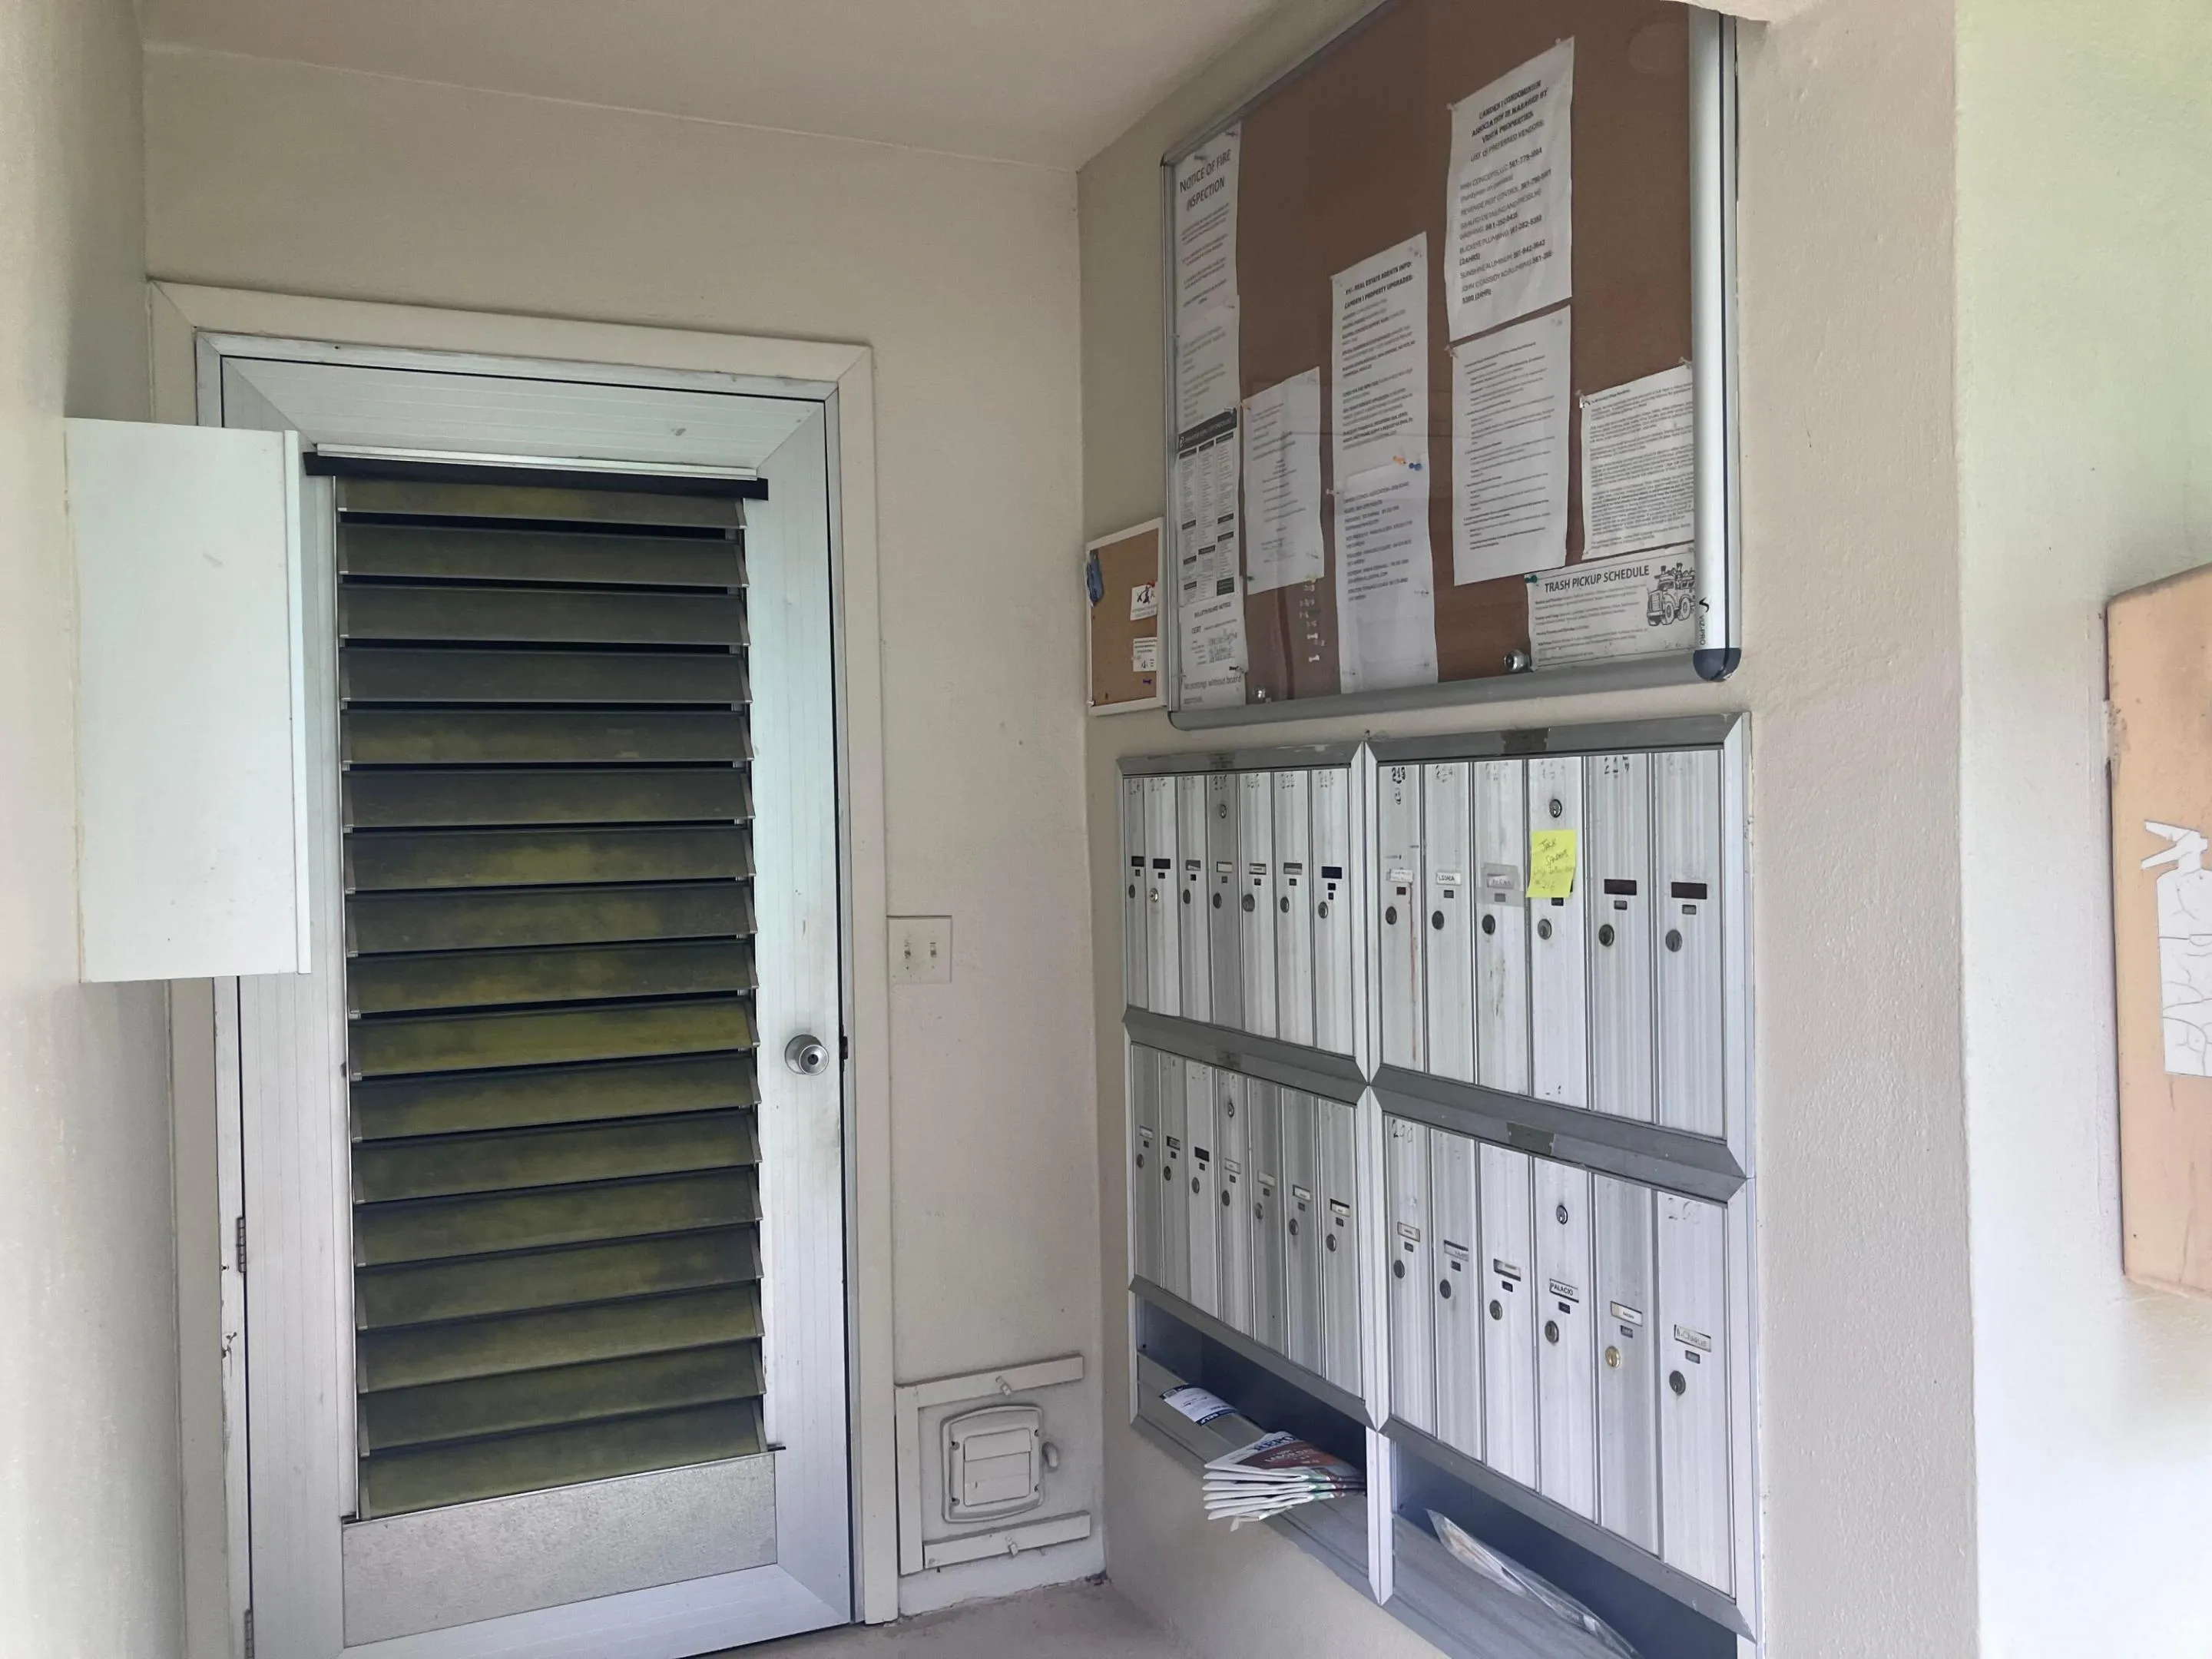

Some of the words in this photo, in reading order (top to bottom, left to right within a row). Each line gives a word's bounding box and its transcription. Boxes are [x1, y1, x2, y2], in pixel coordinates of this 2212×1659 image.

[1179, 167, 1205, 194] NOTICE
[1206, 160, 1216, 176] OF
[1216, 148, 1231, 171] FIRE
[1186, 175, 1225, 212] INSPECTION
[1545, 578, 1570, 593] TRASH
[1571, 574, 1602, 588] PICKUP
[1603, 565, 1650, 583] SCHEDULE
[1550, 1282, 1574, 1296] PALACIO
